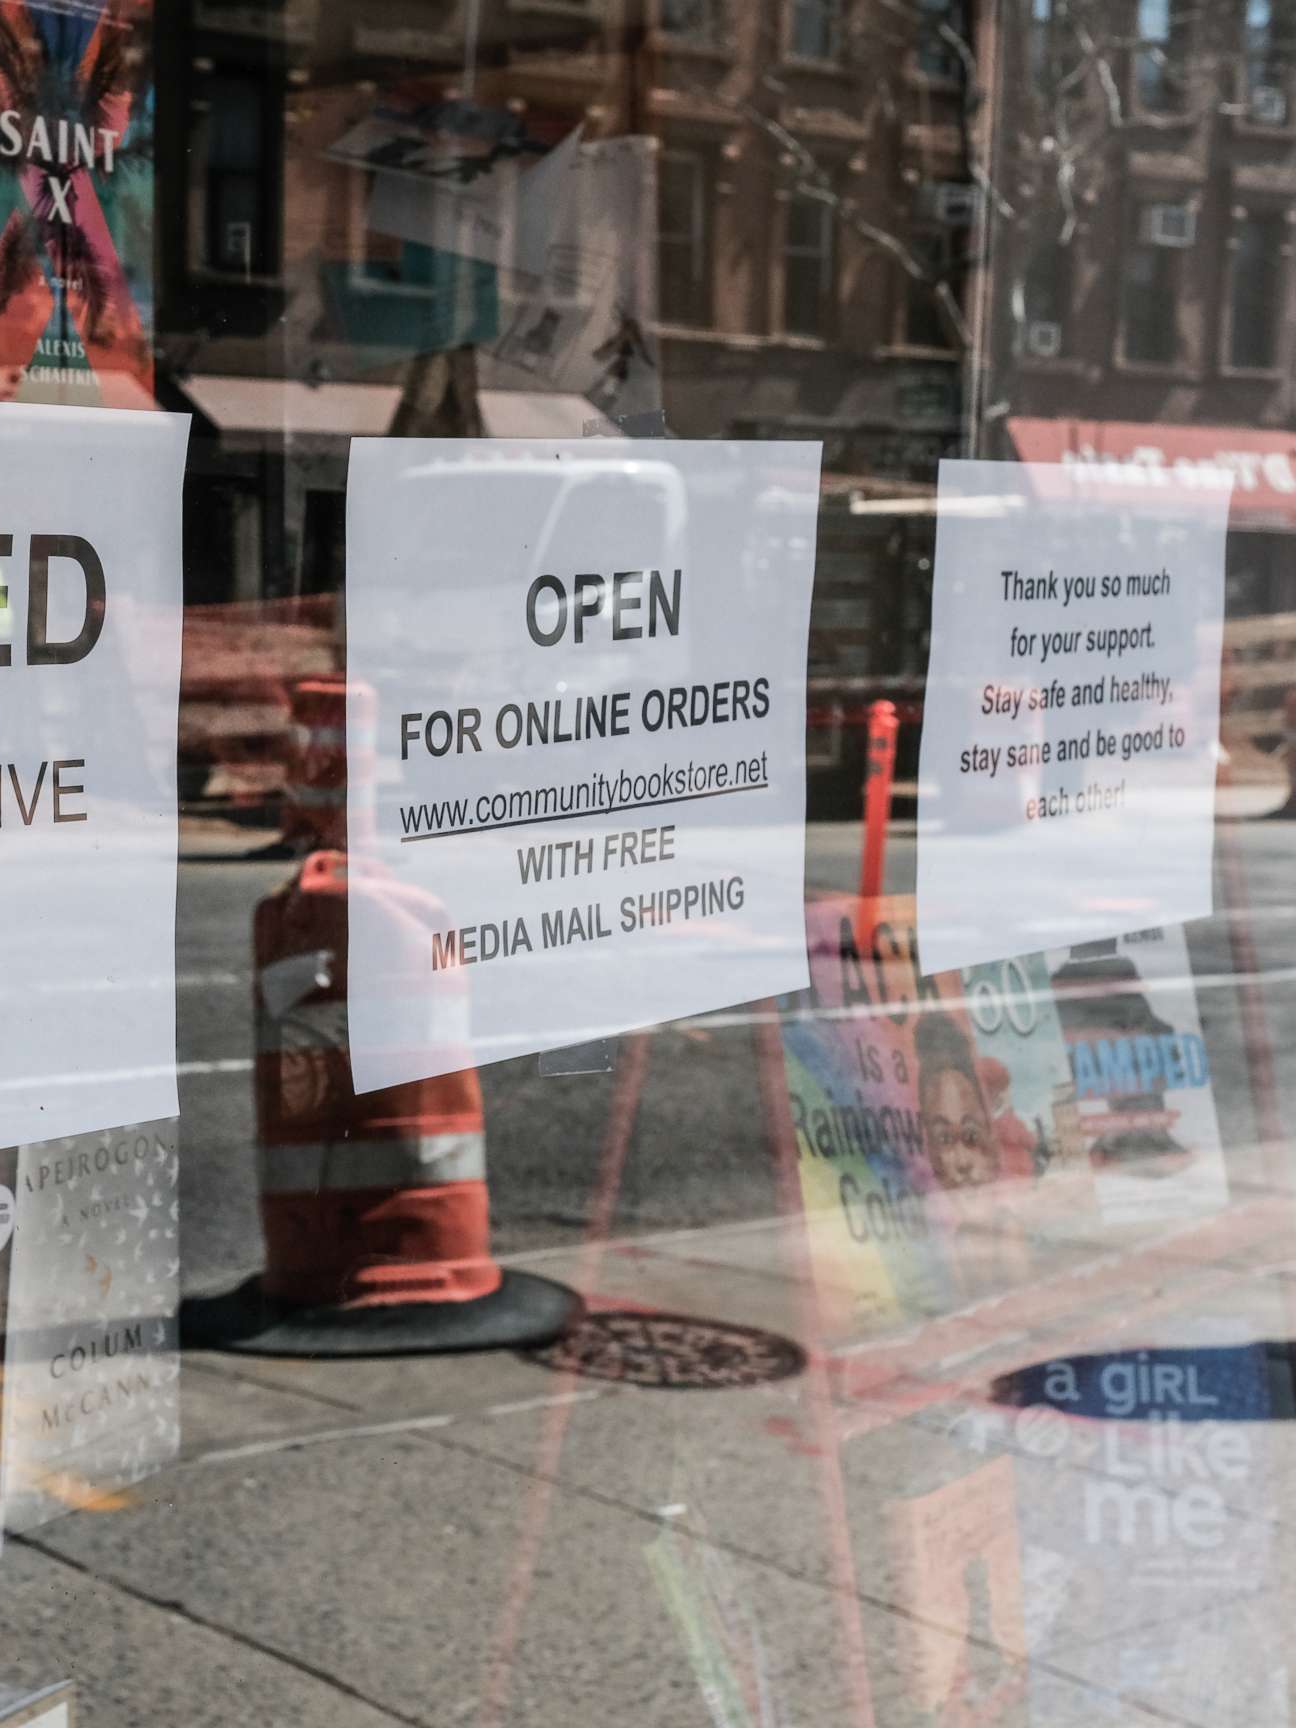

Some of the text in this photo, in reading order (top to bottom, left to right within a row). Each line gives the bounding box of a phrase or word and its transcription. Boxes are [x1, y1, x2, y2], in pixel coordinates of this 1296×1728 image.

[47, 175, 73, 225] X
[35, 337, 86, 358] ALEXIS
[525, 569, 682, 648] OPEN
[1001, 568, 1171, 607] Thank you so much
[1010, 621, 1156, 663] for your support.
[400, 676, 771, 761] FOR ONLINE ORDERS
[981, 671, 1174, 720] Stay safe and healthy,
[960, 723, 1185, 778] stay sane and be good to
[400, 750, 769, 835] www.communitybookstore.net
[1026, 779, 1126, 821] each other!
[517, 824, 676, 885] WITH FREE
[432, 875, 745, 971] MEDIA MAIL SHIPPING
[856, 1039, 882, 1084] Is
[1065, 1033, 1211, 1098] AMPED
[791, 1091, 926, 1160] Rainbow
[1043, 1360, 1080, 1401] a
[1085, 1481, 1228, 1548] me
